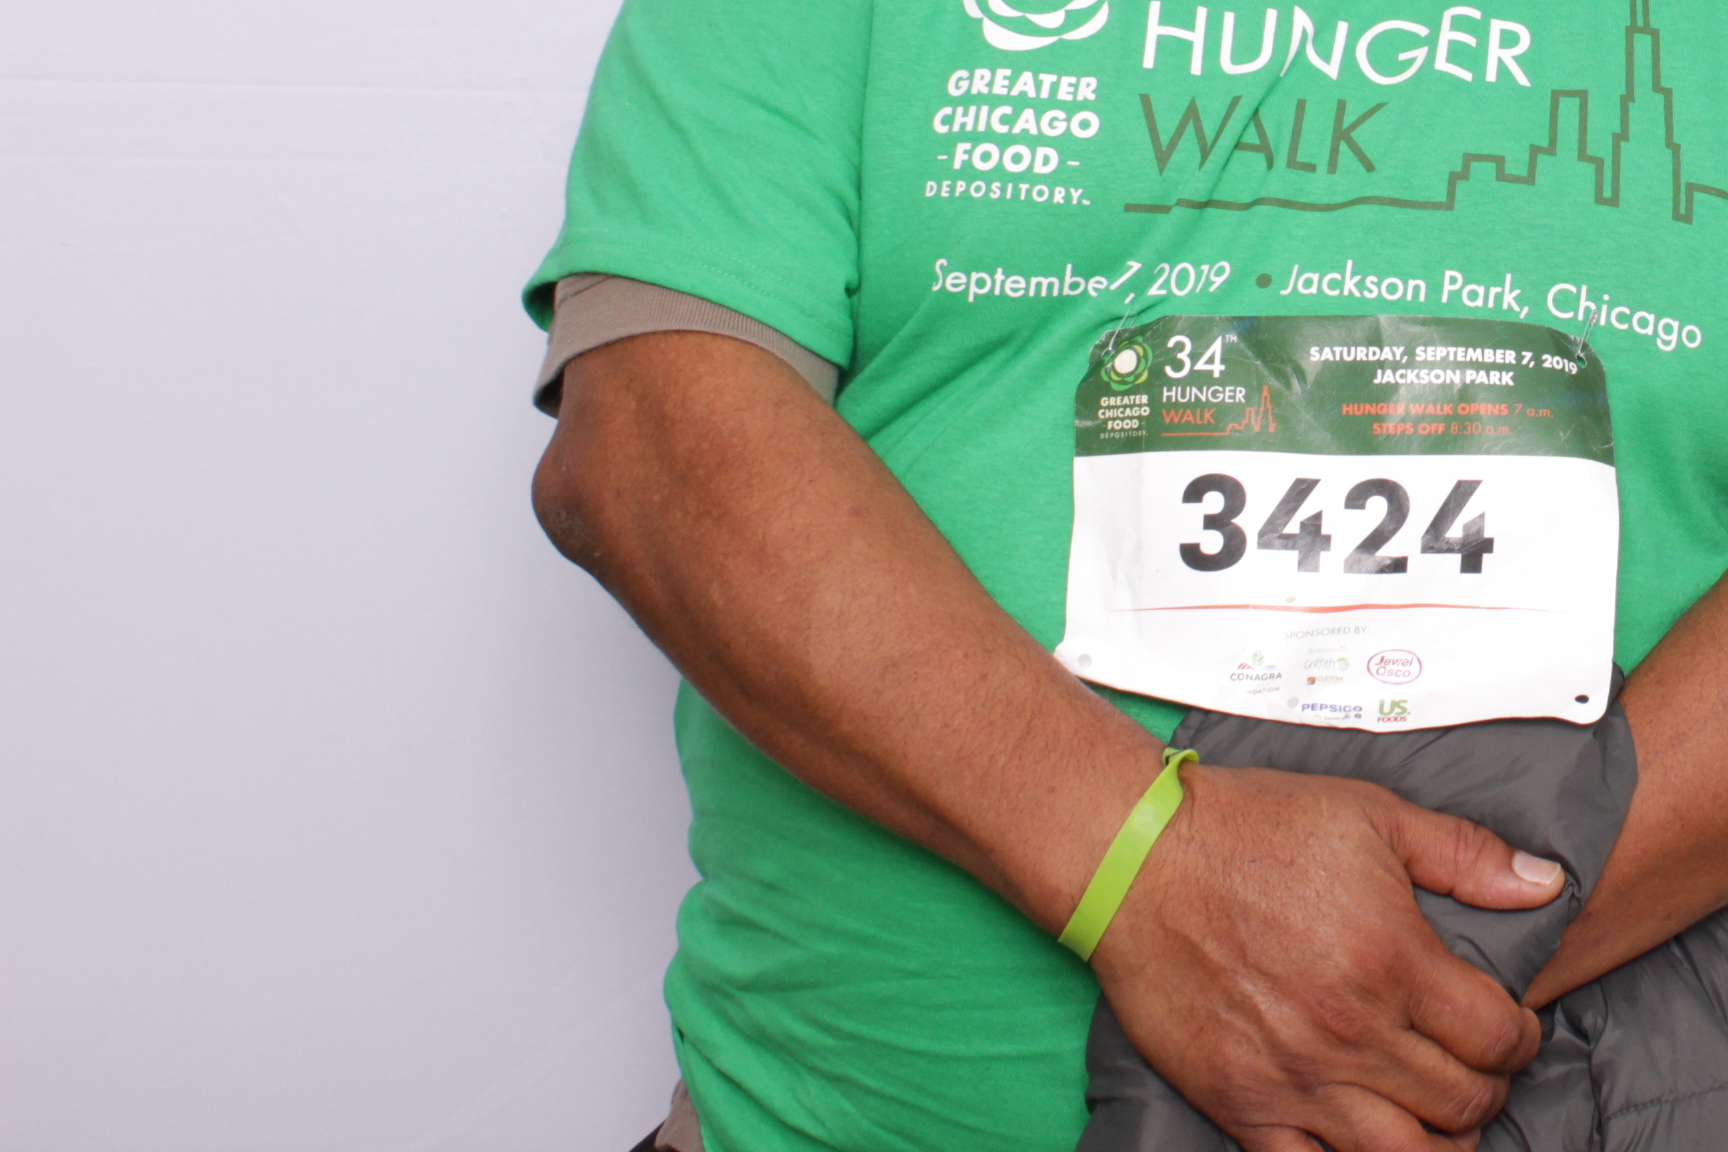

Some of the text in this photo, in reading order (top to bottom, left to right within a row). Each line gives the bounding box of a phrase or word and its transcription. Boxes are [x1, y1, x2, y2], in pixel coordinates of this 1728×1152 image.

[1142, 0, 1531, 87] HUNGER
[946, 68, 1098, 102] GREATER
[932, 105, 1101, 139] CHICAGO
[1139, 93, 1389, 176] WALK
[931, 258, 1108, 302] Septembe
[1147, 261, 1231, 296] 2019
[1279, 259, 1702, 352] Jackson Park, Chicago
[1309, 346, 1579, 375] SATURDAY, SEPTEMBER 7, 2019
[1373, 369, 1515, 386] JACKSON PARK
[1100, 394, 1148, 408] GREATER
[1162, 386, 1246, 403] HUNGER
[1098, 406, 1150, 419] CHICAGO
[1161, 408, 1217, 425] WALK
[1341, 403, 1554, 418] HUNGER WALK OPENS 7 a.m.
[1372, 421, 1513, 436] STEPS OFF 8:30 a.m.
[1178, 473, 1495, 575] 3424
[1283, 626, 1350, 640] SPONSORED
[1374, 655, 1414, 668] Jewel
[1230, 672, 1283, 682] CONAGRA
[1301, 703, 1363, 713] PEPSICO
[1377, 715, 1407, 724] FOODS
